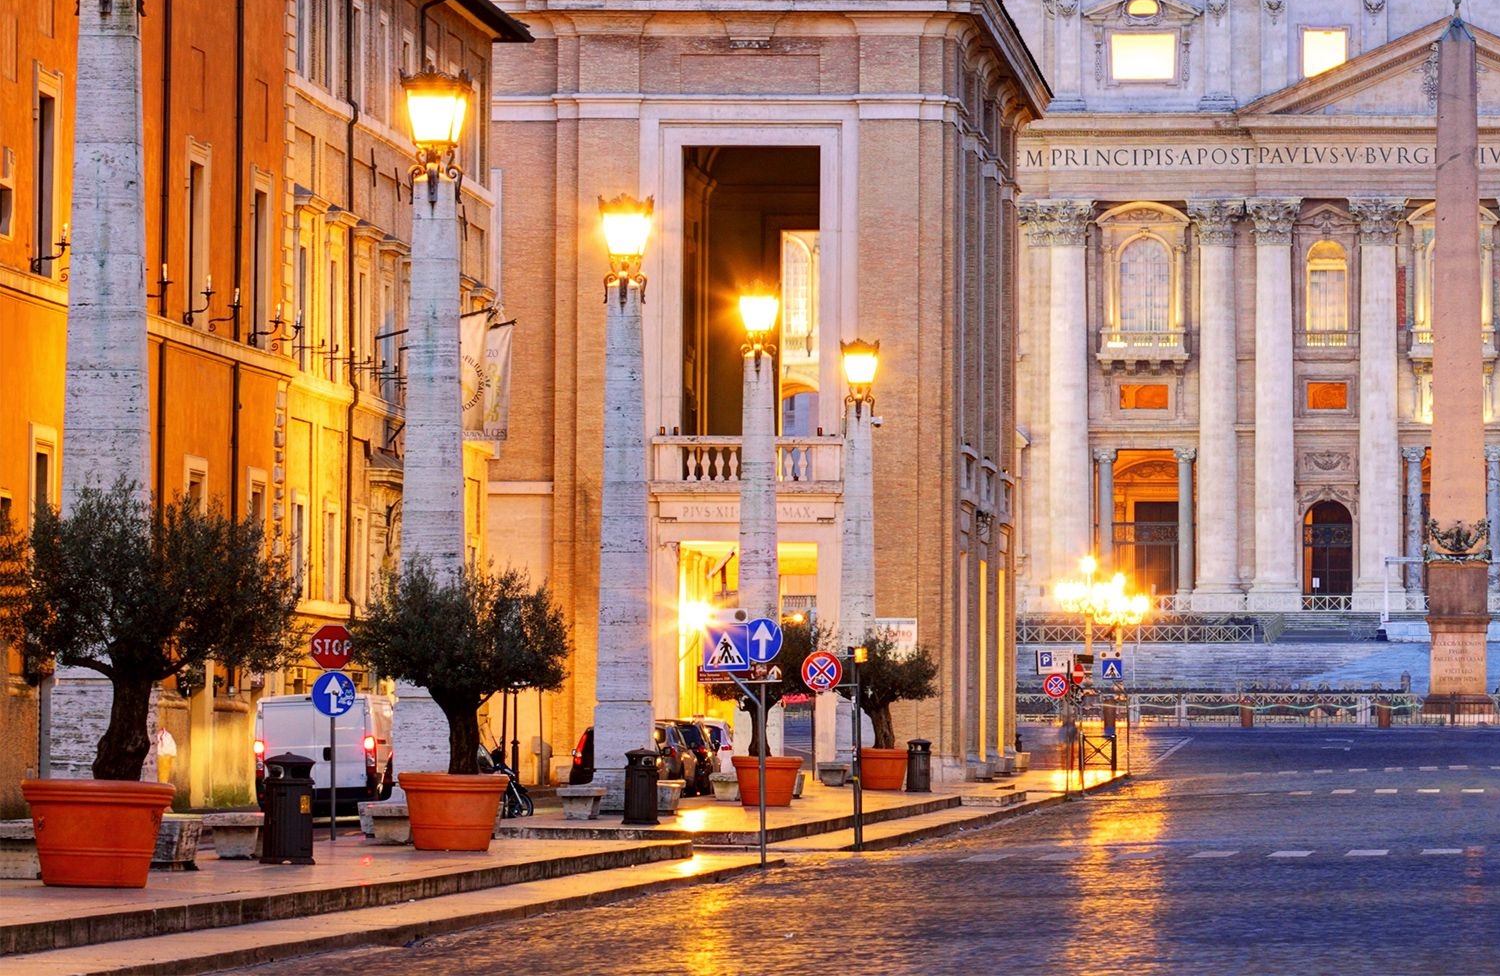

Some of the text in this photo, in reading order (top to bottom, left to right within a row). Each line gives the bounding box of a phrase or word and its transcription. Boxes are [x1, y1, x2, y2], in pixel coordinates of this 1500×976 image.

[1051, 148, 1174, 166] PRINCIPIS
[1179, 147, 1254, 166] APOST
[1259, 146, 1339, 165] PAVLVS
[1344, 146, 1360, 165] V
[682, 506, 710, 518] PIVS
[313, 638, 353, 656] STOP
[1043, 656, 1050, 665] P
